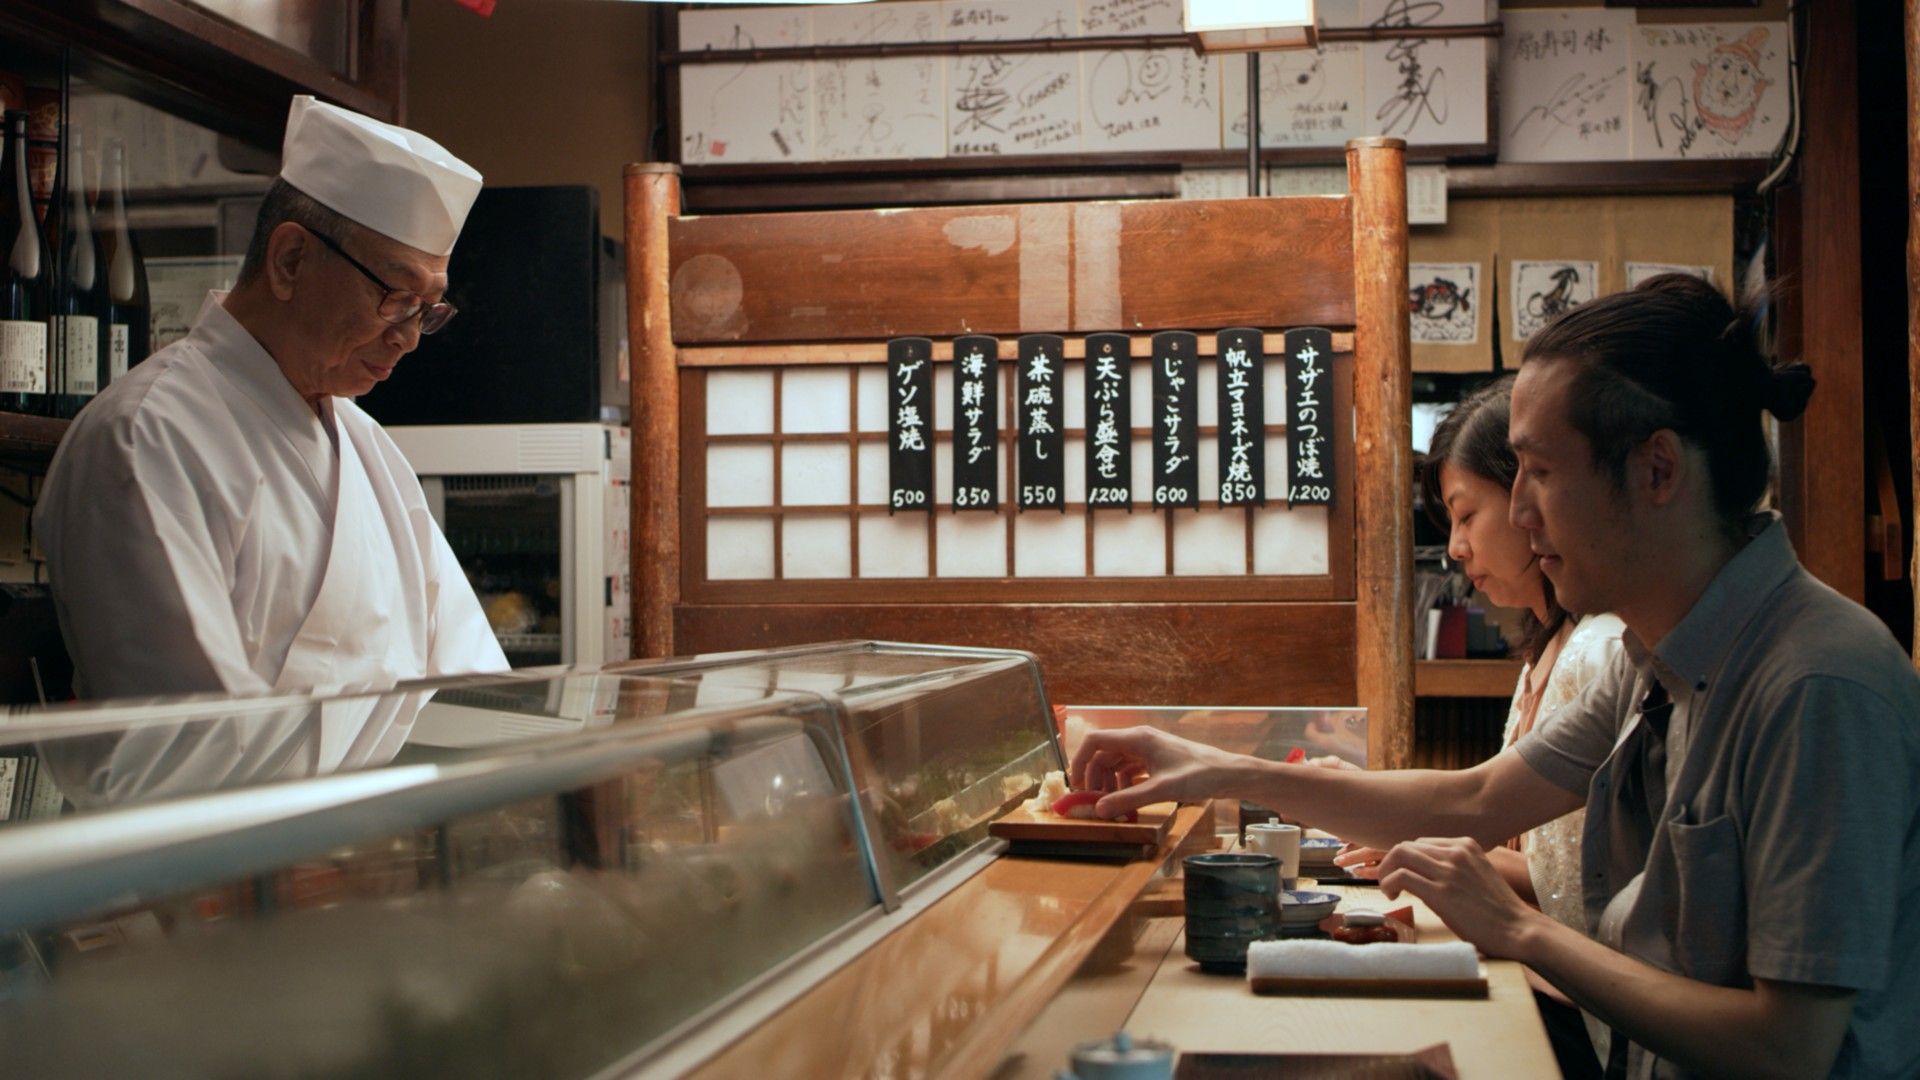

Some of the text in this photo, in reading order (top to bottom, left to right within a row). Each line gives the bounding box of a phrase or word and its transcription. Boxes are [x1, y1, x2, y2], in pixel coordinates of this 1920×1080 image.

[896, 360, 926, 451] ゲソ塩焼
[961, 353, 991, 464] 海鮮サラダ
[1024, 353, 1055, 460] 茶碗蒸し
[1225, 348, 1254, 482] 帆立マヨネーズ焼
[1295, 346, 1325, 479] サザエのつぼ焼
[893, 489, 926, 508] 500
[956, 486, 990, 506] 850
[1023, 485, 1056, 505] 550
[1155, 485, 1188, 505] 600
[1220, 482, 1256, 503] 850
